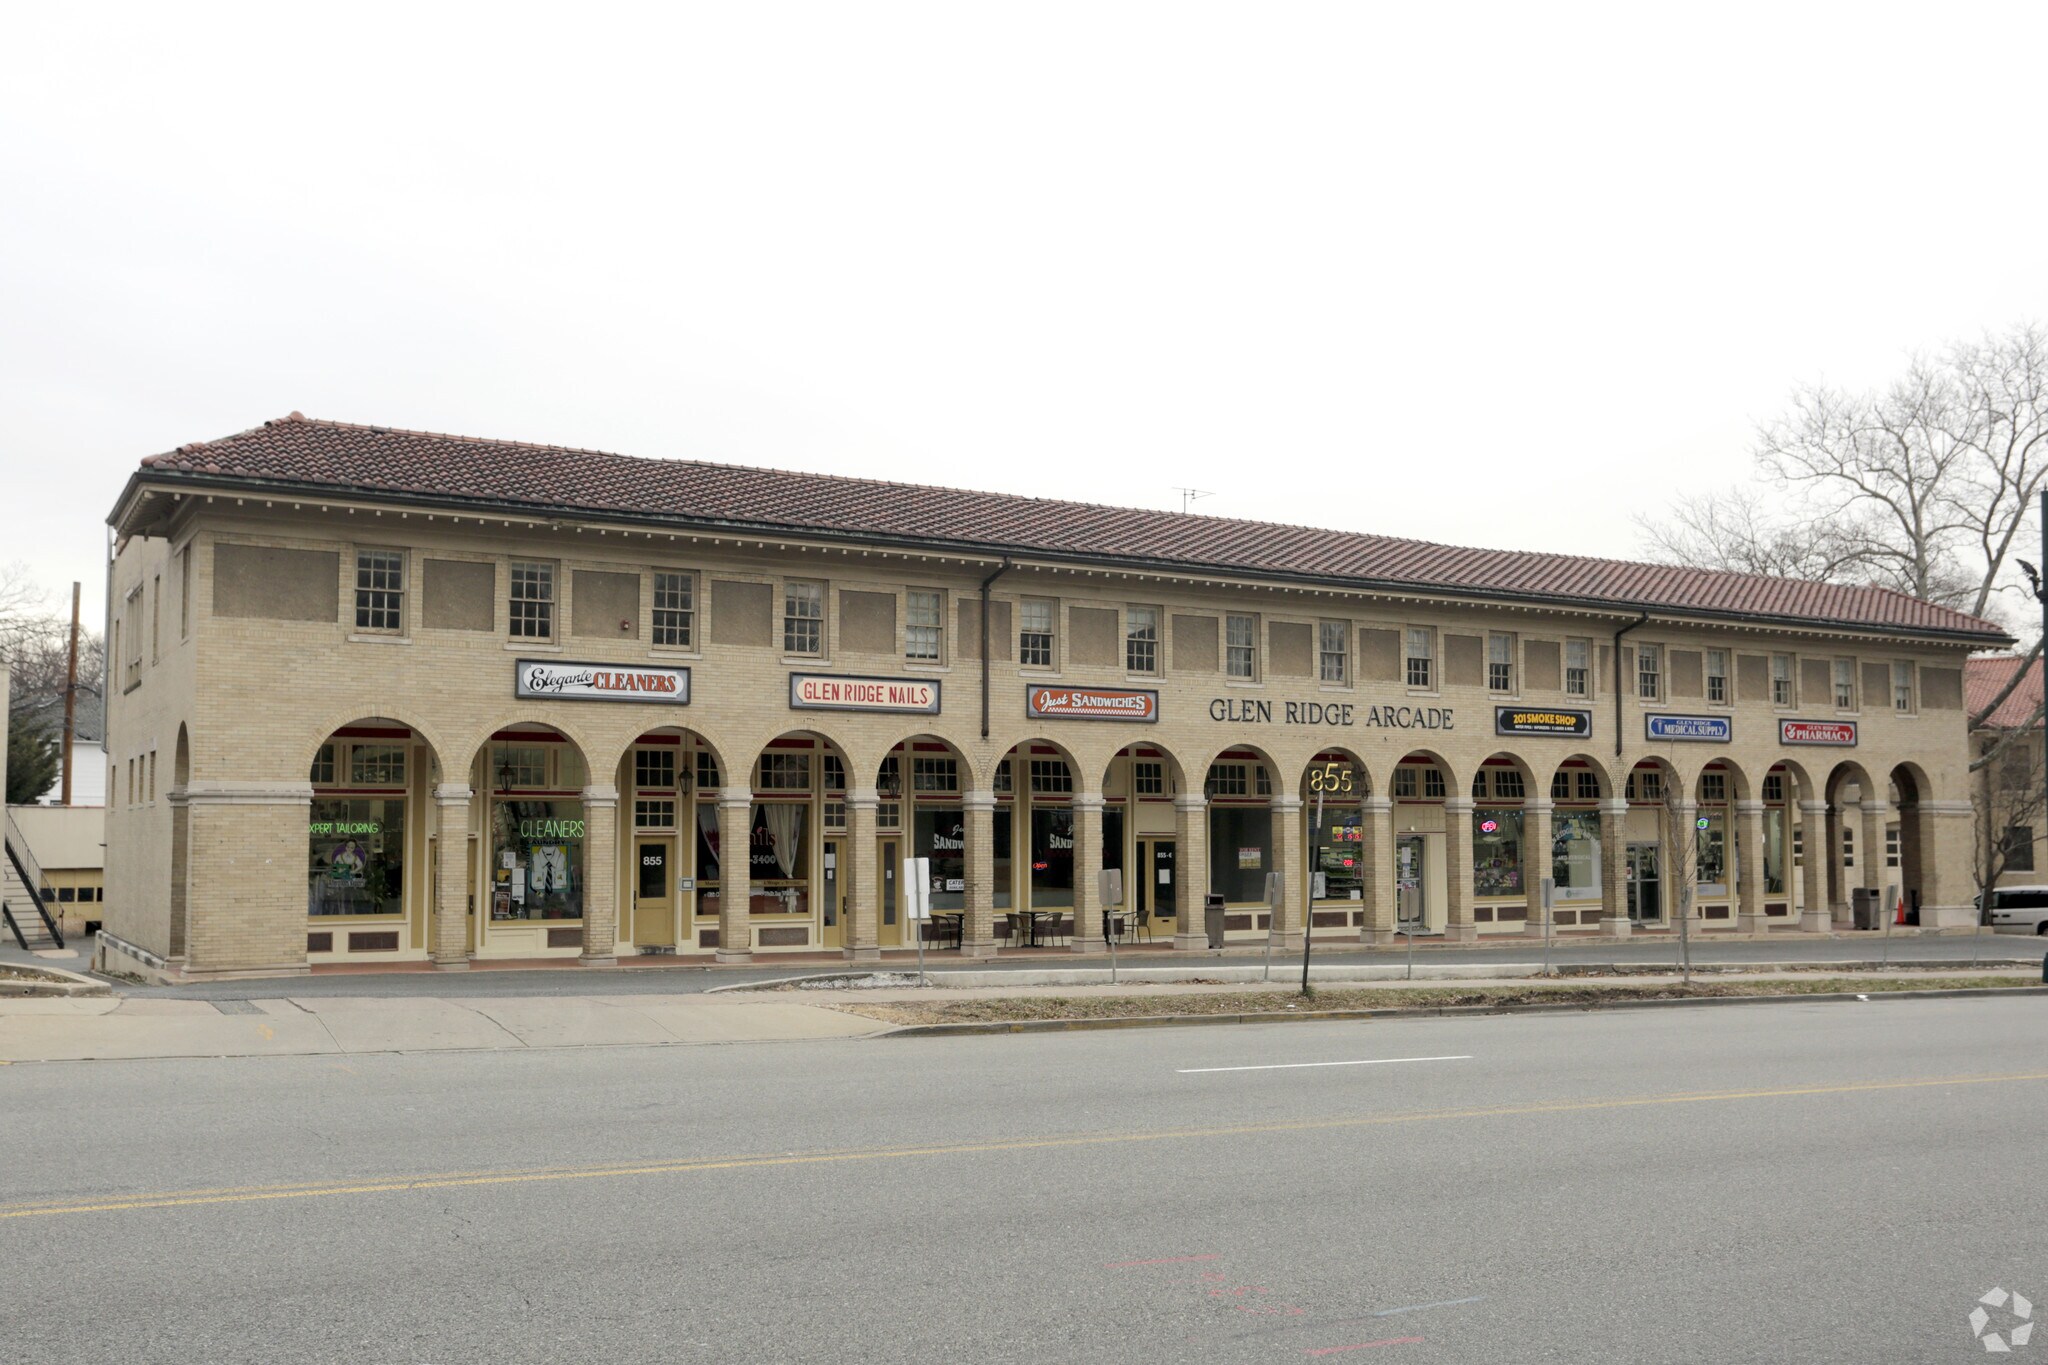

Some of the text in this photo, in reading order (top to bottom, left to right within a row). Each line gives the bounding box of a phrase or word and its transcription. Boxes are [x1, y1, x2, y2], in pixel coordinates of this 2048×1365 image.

[530, 668, 676, 692] Elegante CLEANERS
[804, 682, 928, 704] GLEN RIDGE NAILS
[1040, 691, 1145, 712] Just SANDWICHES
[1209, 698, 1454, 729] GLEN RIDGE ARCADE
[1513, 713, 1576, 726] 201 SMOKE SHOP
[1664, 724, 1724, 736] MEDICAL SUPPLY
[1796, 730, 1851, 741] PHARMACY
[1311, 763, 1352, 791] 855
[308, 823, 379, 834] XPERT TAILORING
[521, 820, 585, 838] CLEANERS
[933, 833, 965, 849] SANDW
[643, 856, 662, 866] 855
